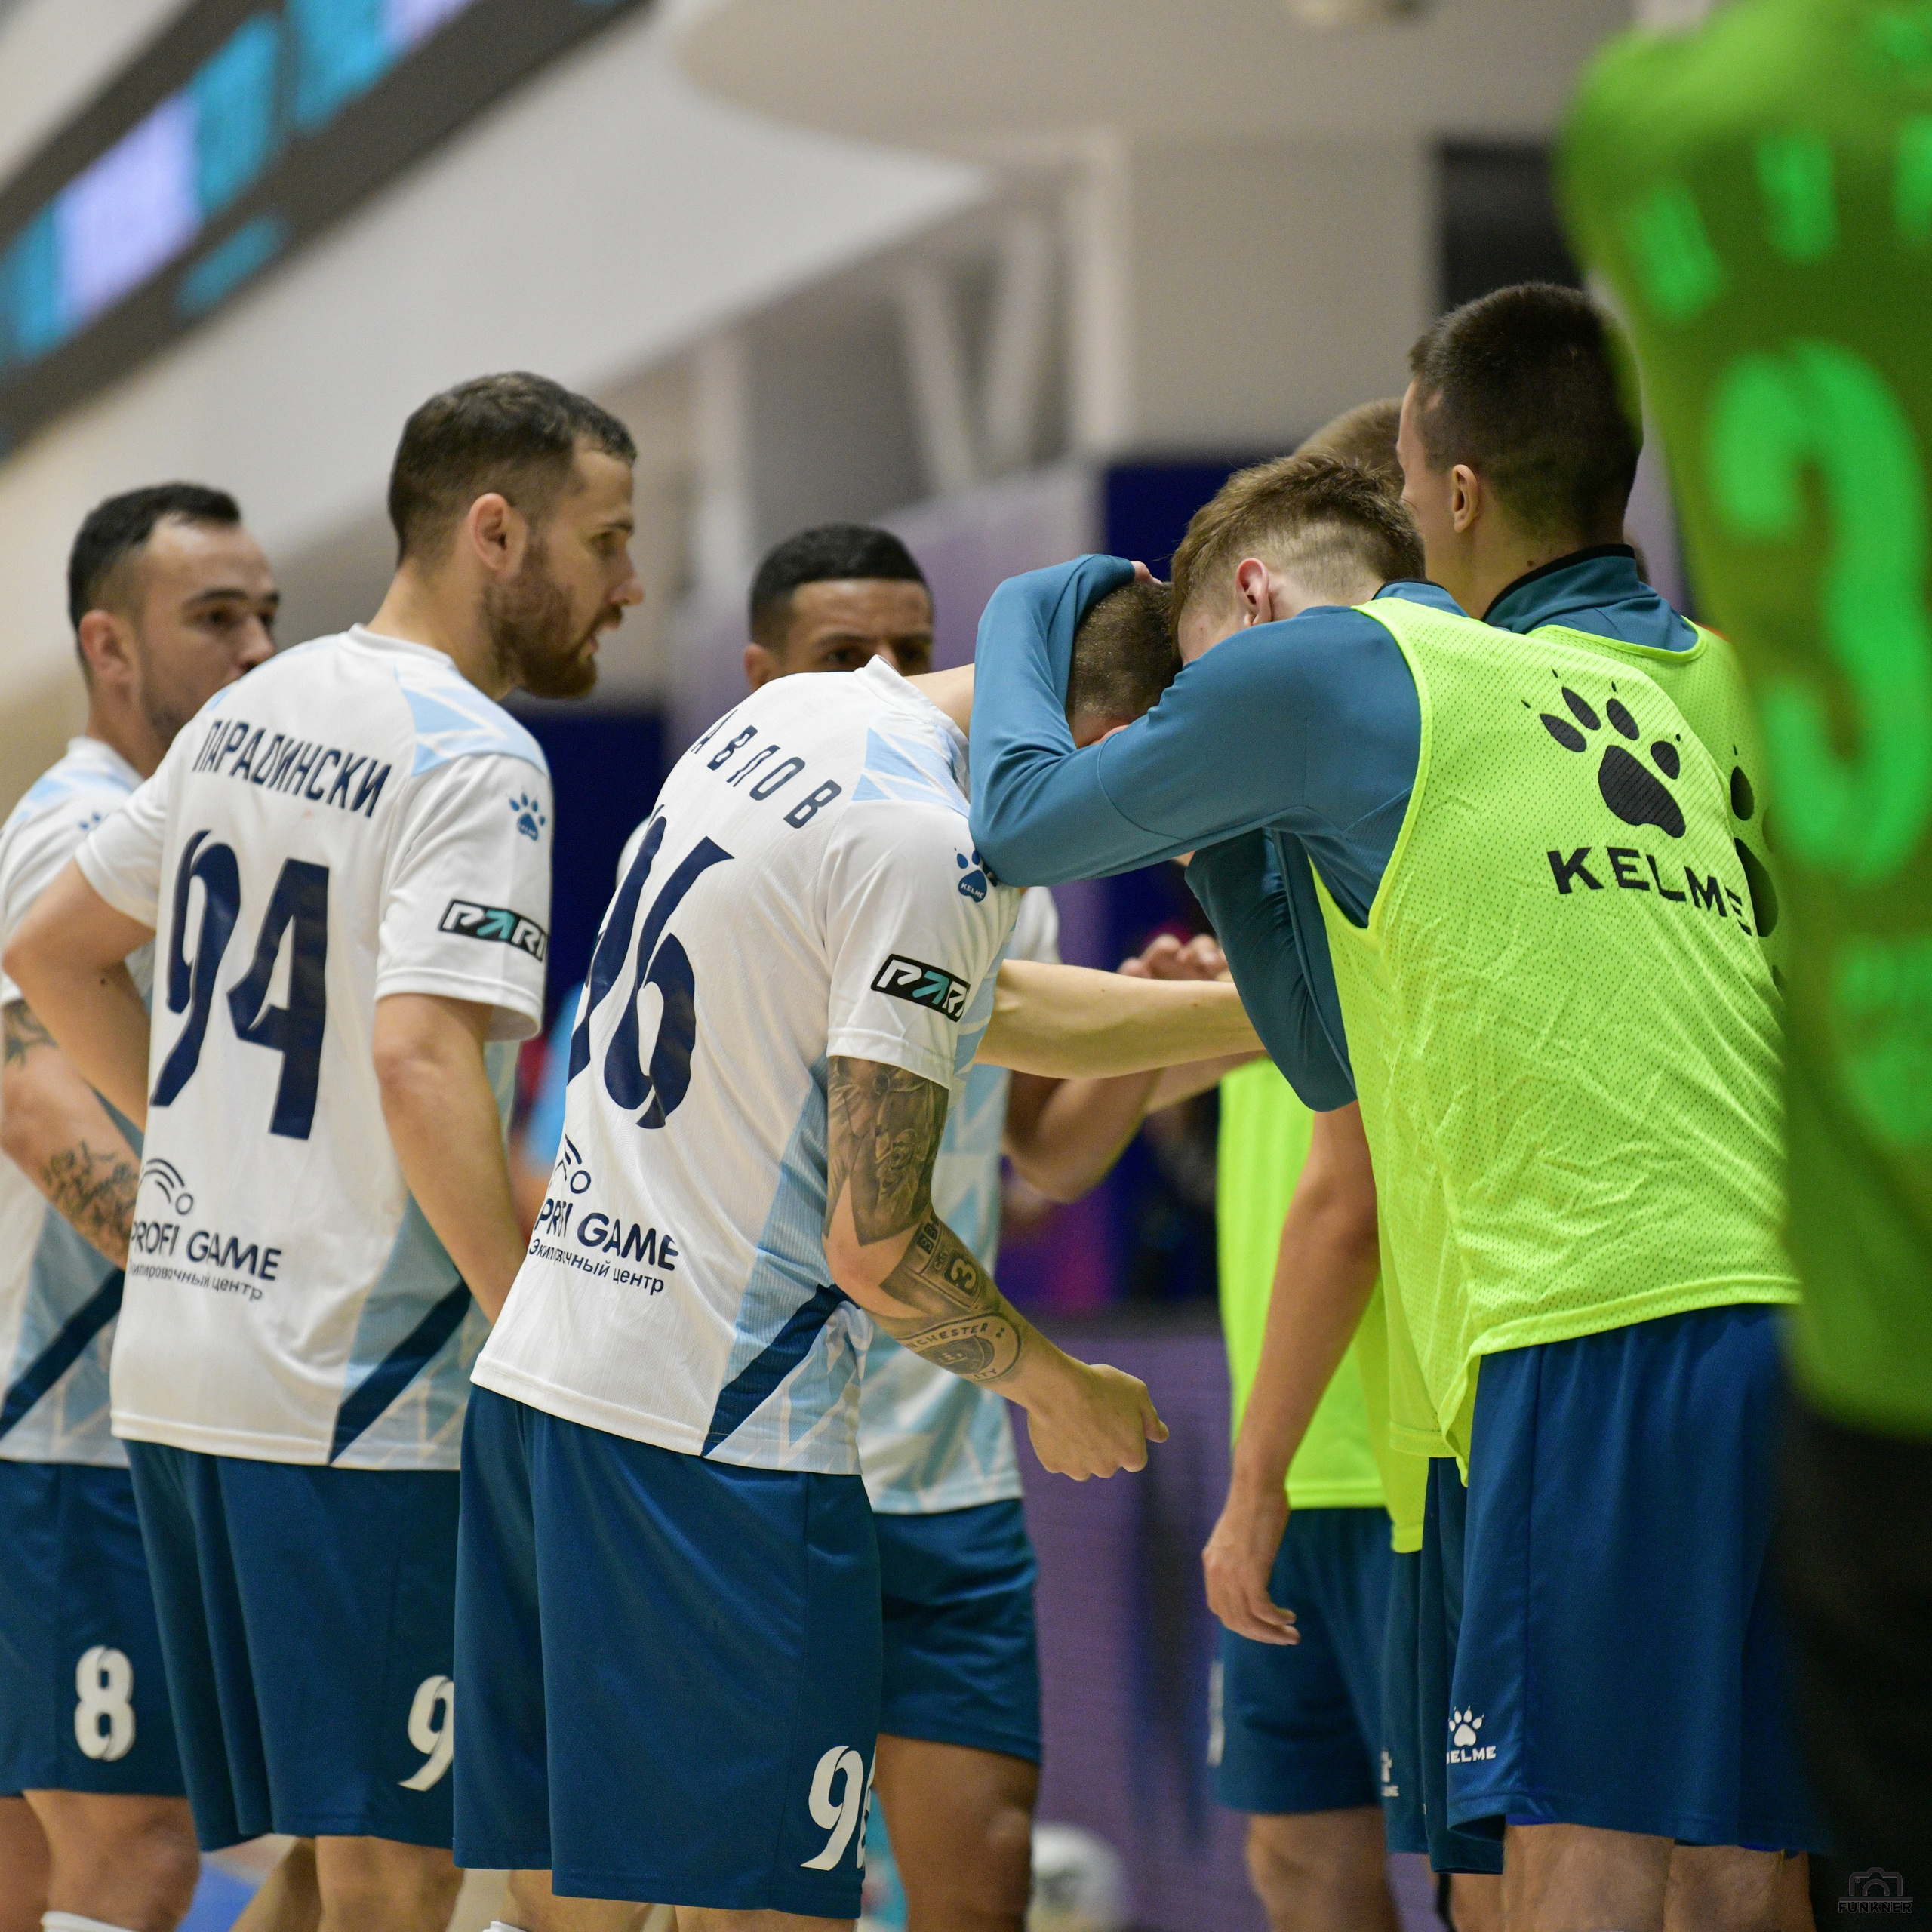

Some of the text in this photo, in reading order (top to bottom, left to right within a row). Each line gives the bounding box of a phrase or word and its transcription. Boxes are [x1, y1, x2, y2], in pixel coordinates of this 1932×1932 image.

[192, 719, 392, 817] ПАРАДИНСКИ
[961, 882, 985, 899] KELME
[1547, 846, 1752, 937] KELME
[149, 830, 330, 1141] 94
[876, 958, 968, 1018] PAR
[186, 1229, 282, 1281] GAME
[577, 1212, 679, 1271] GAME
[211, 1277, 263, 1301] центр
[613, 1267, 664, 1296] центр
[74, 1644, 136, 1762] 8
